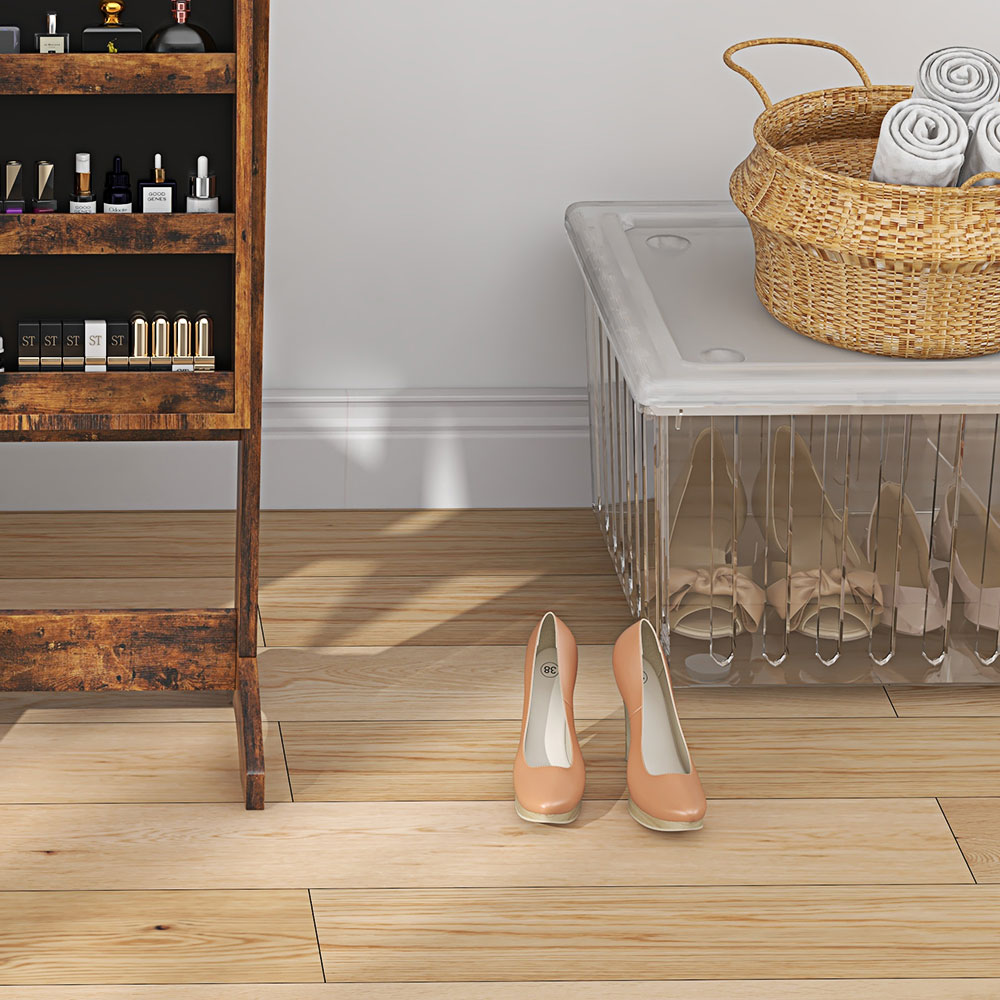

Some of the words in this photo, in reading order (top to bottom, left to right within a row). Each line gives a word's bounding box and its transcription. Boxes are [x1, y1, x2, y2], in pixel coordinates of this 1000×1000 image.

[22, 335, 36, 347] ST
[44, 335, 58, 347] ST
[66, 335, 80, 347] ST
[88, 335, 102, 347] ST
[111, 335, 125, 347] ST
[544, 665, 557, 674] 38
